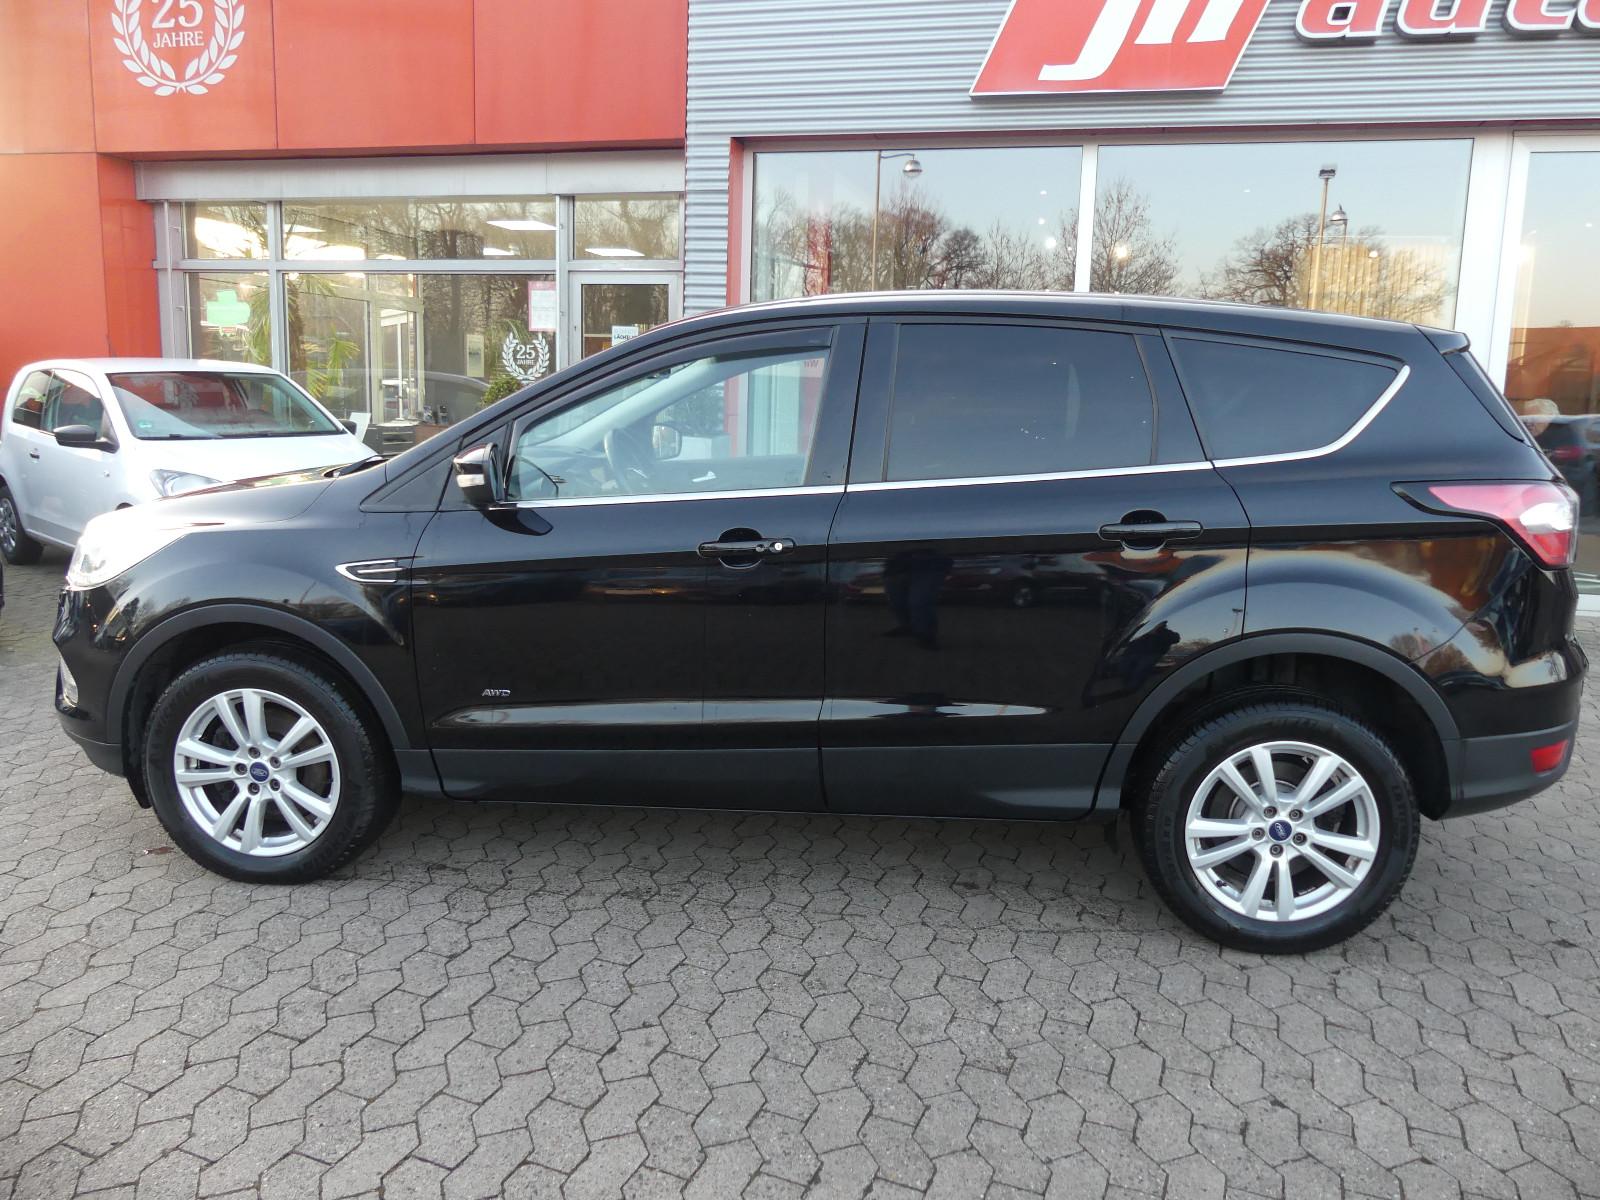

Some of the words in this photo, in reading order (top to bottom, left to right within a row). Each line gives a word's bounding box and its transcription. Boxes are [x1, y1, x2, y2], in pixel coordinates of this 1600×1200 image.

[152, 0, 204, 28] 25
[153, 31, 205, 48] JAHRE
[516, 344, 536, 359] 25
